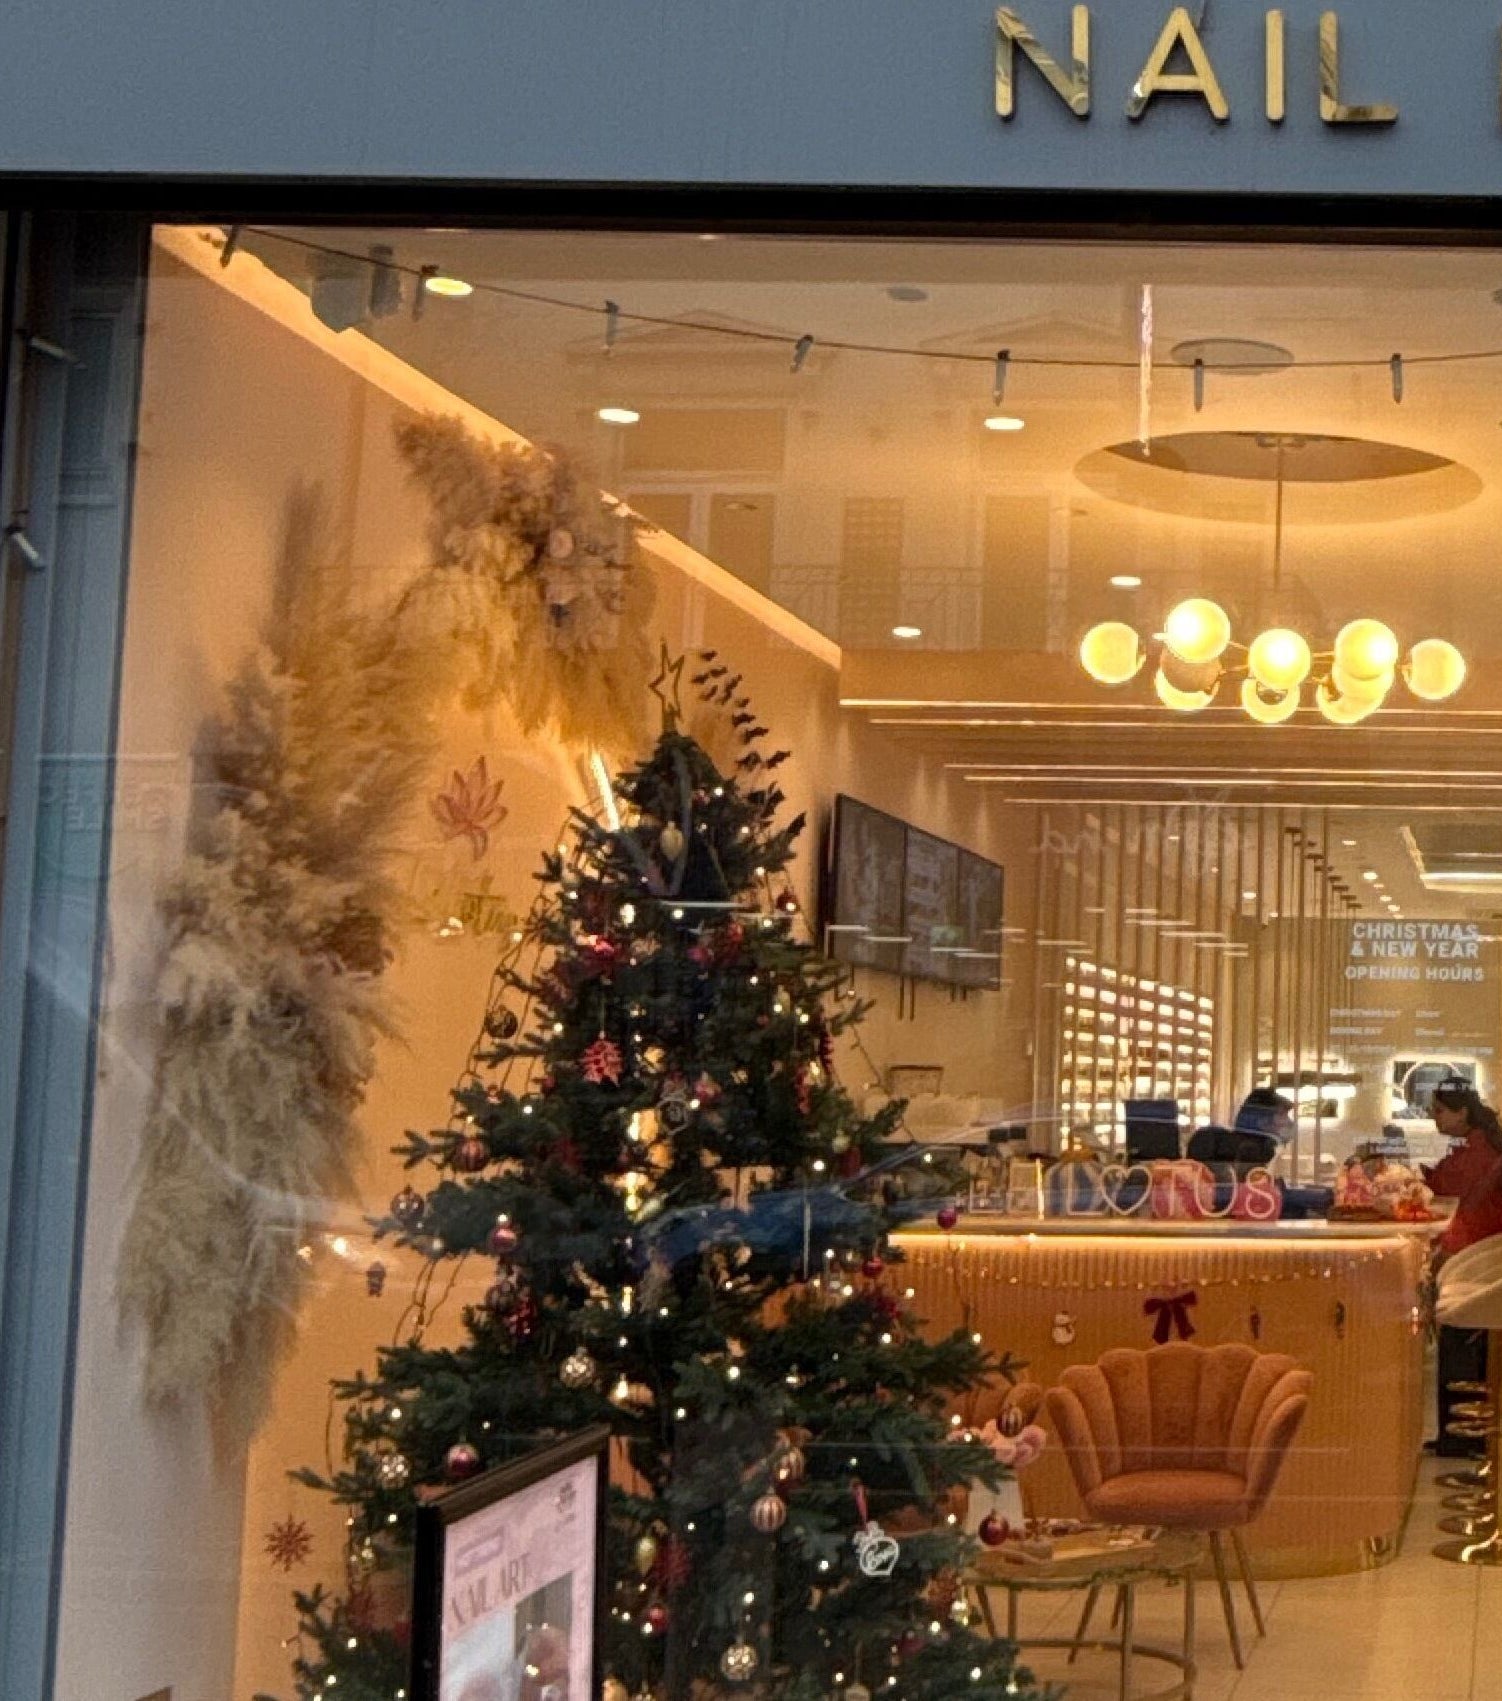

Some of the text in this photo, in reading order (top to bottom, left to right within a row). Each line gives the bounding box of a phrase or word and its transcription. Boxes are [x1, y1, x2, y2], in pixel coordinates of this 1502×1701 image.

[995, 3, 1399, 123] NAIL
[1353, 922, 1479, 940] CHRISTMAS
[1350, 940, 1479, 959] & NEW YEAR
[1345, 964, 1484, 981] OPENING HOURS
